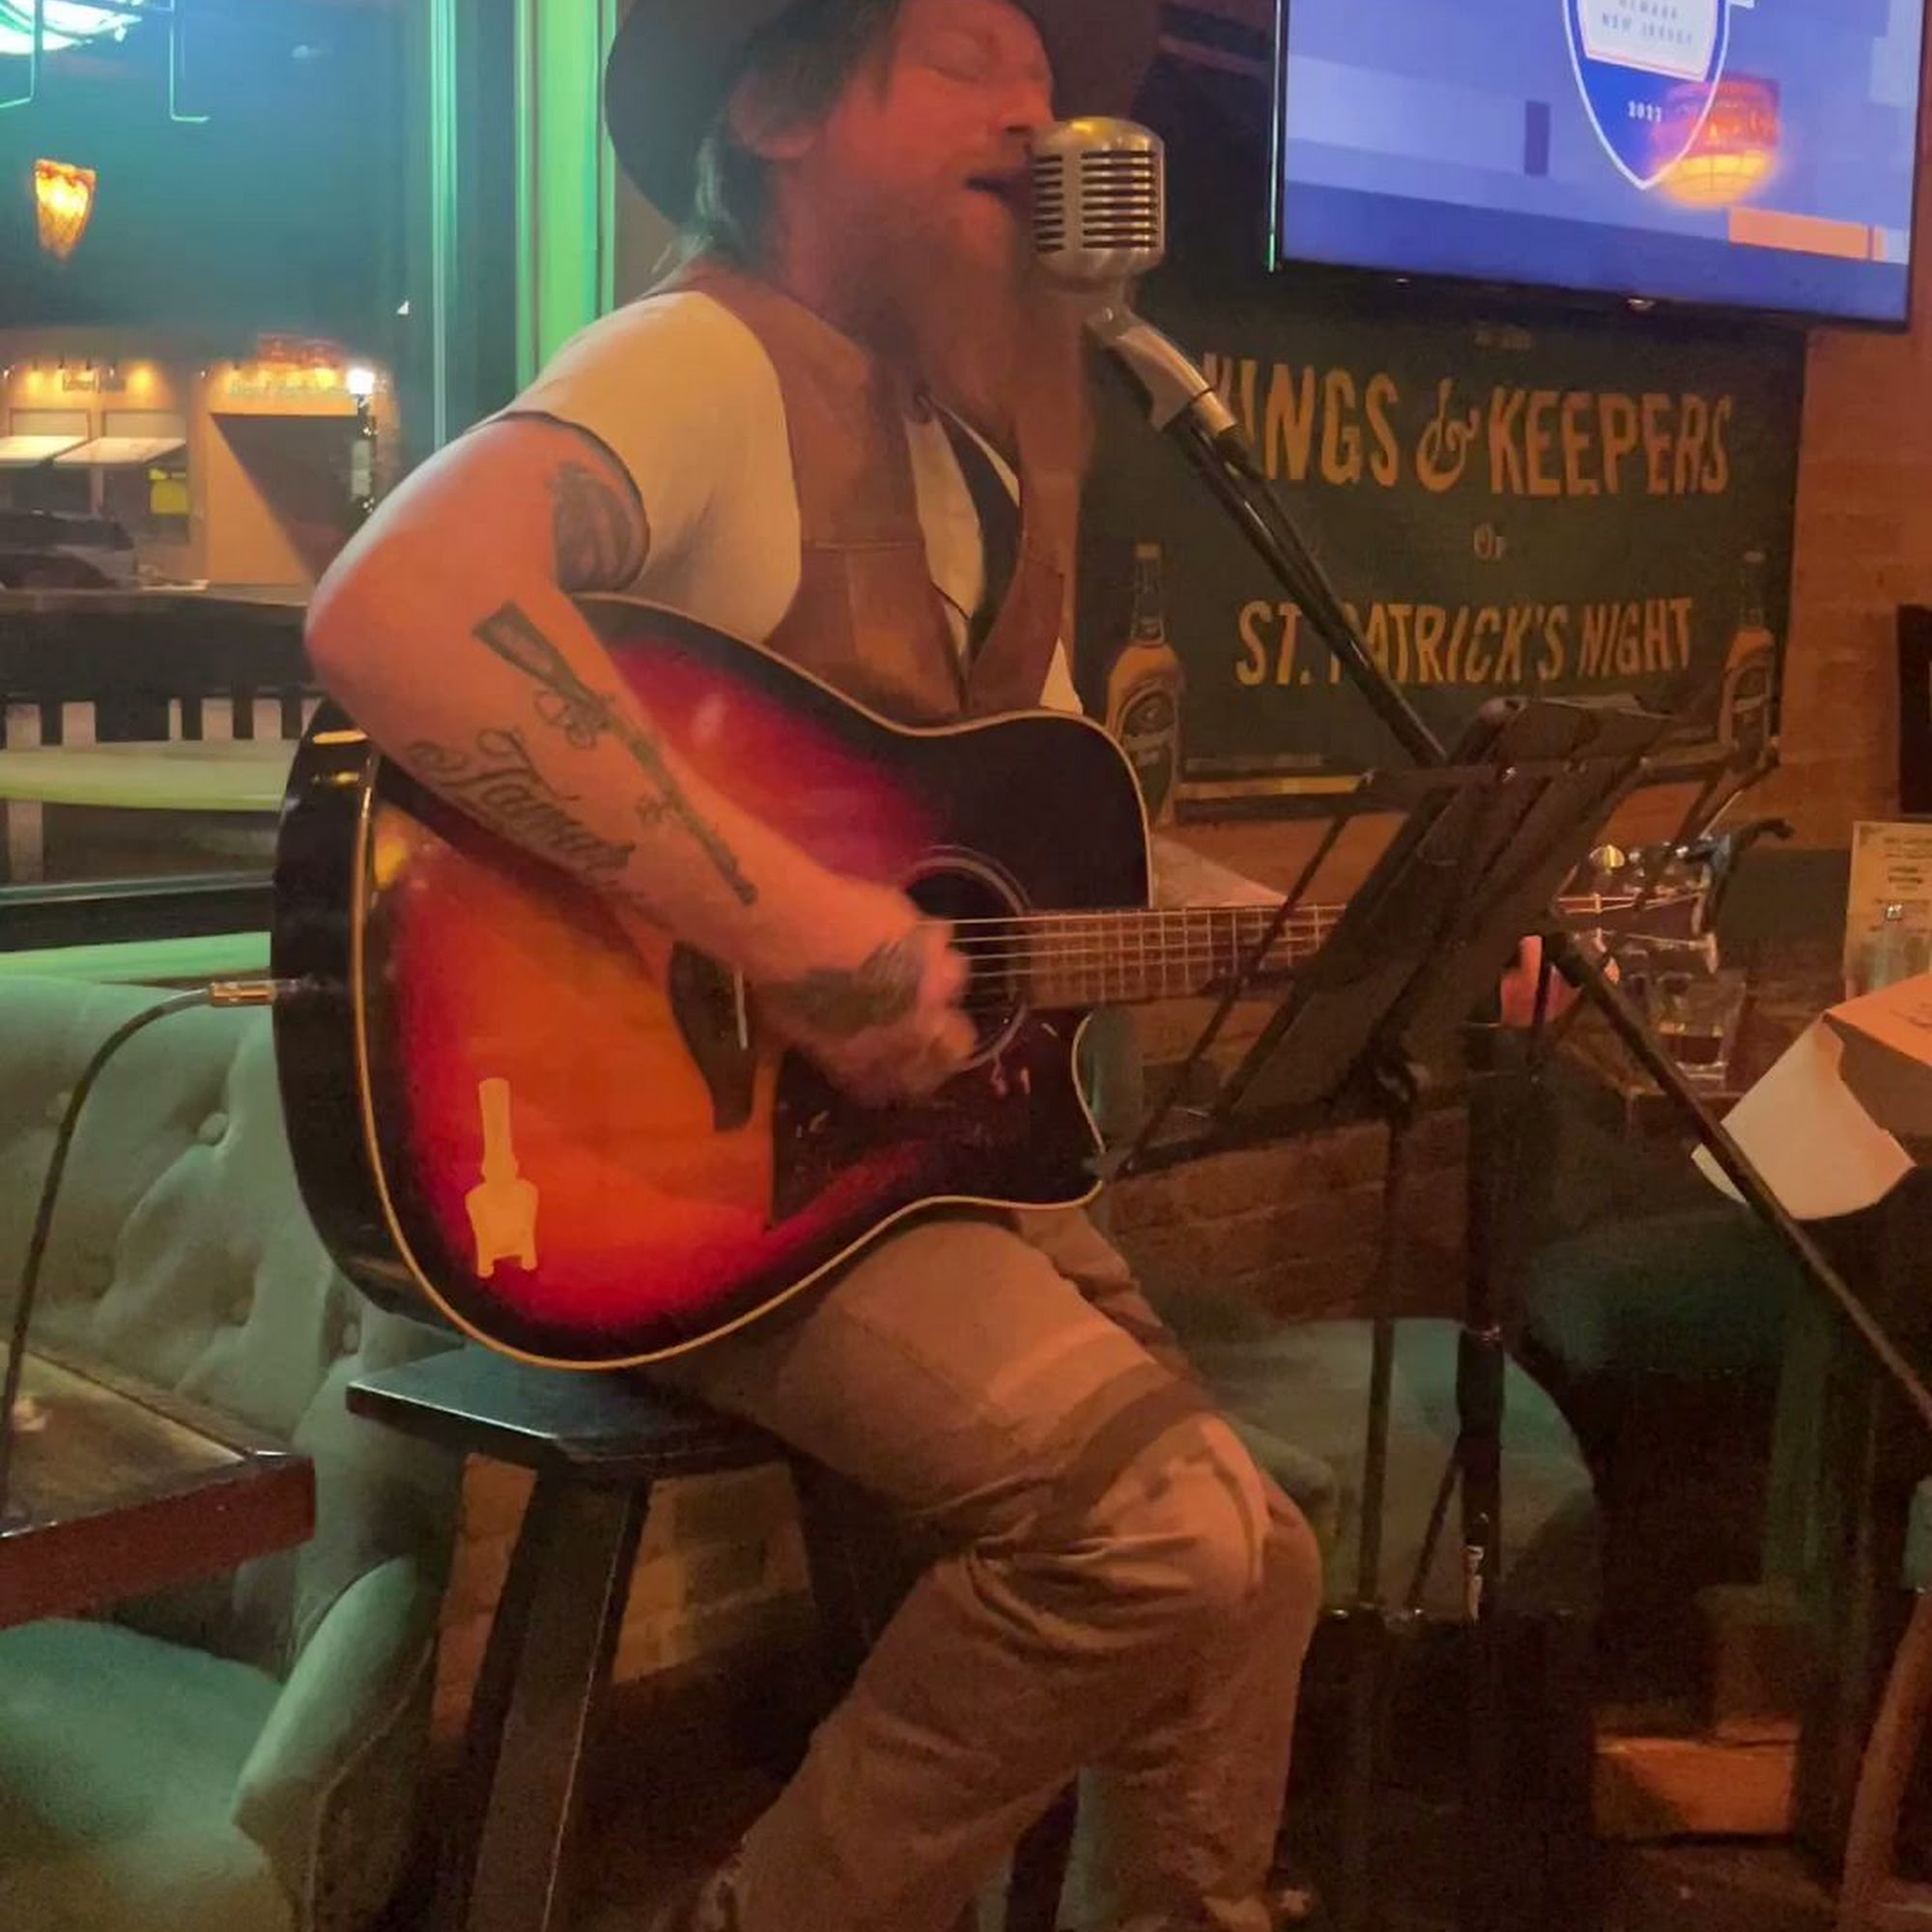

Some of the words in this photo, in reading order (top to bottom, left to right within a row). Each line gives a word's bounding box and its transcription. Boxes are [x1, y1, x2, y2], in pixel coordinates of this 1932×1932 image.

[1415, 377, 1481, 494] &
[1489, 387, 1732, 497] KEEPERS
[1236, 600, 1311, 685] ST.
[1577, 597, 1692, 678] NIGHT
